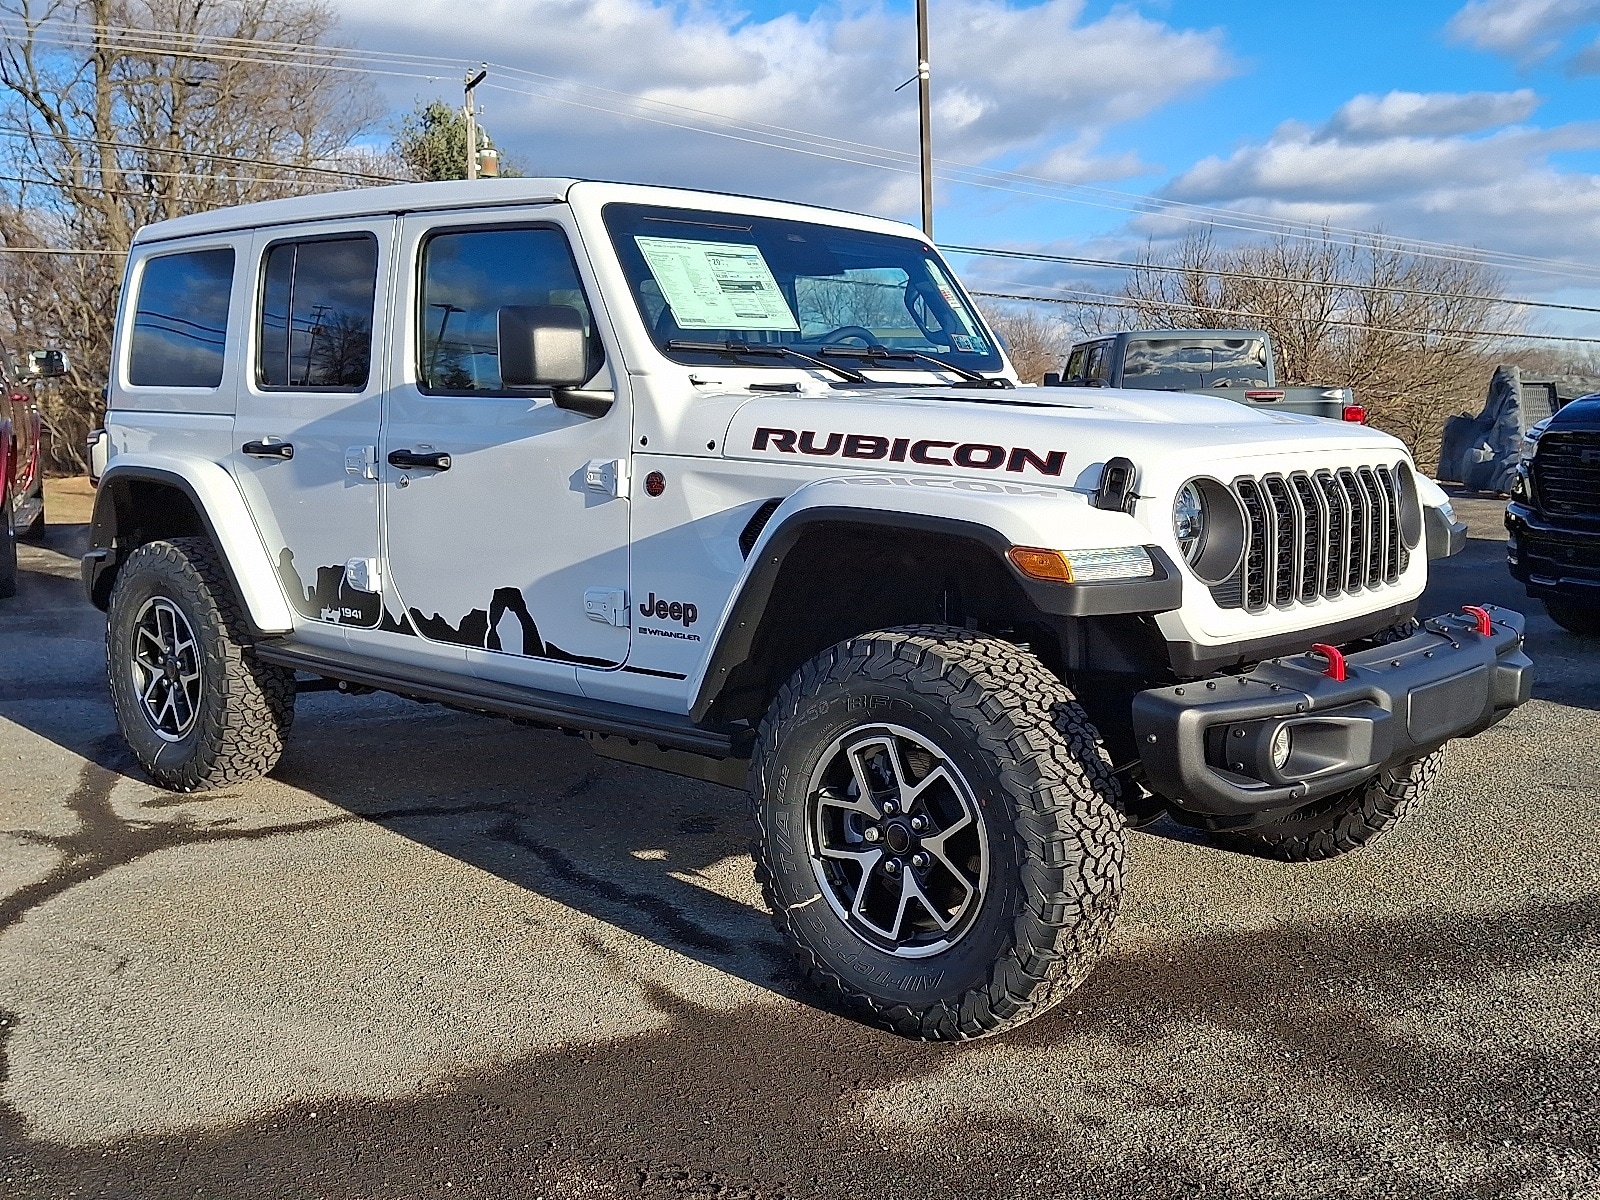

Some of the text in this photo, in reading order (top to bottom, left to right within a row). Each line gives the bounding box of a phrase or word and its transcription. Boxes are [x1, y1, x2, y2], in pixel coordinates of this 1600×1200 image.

[751, 427, 1067, 476] RUBICON
[341, 607, 362, 620] 1941
[639, 592, 698, 627] Jeep
[647, 628, 701, 642] WRANGLER
